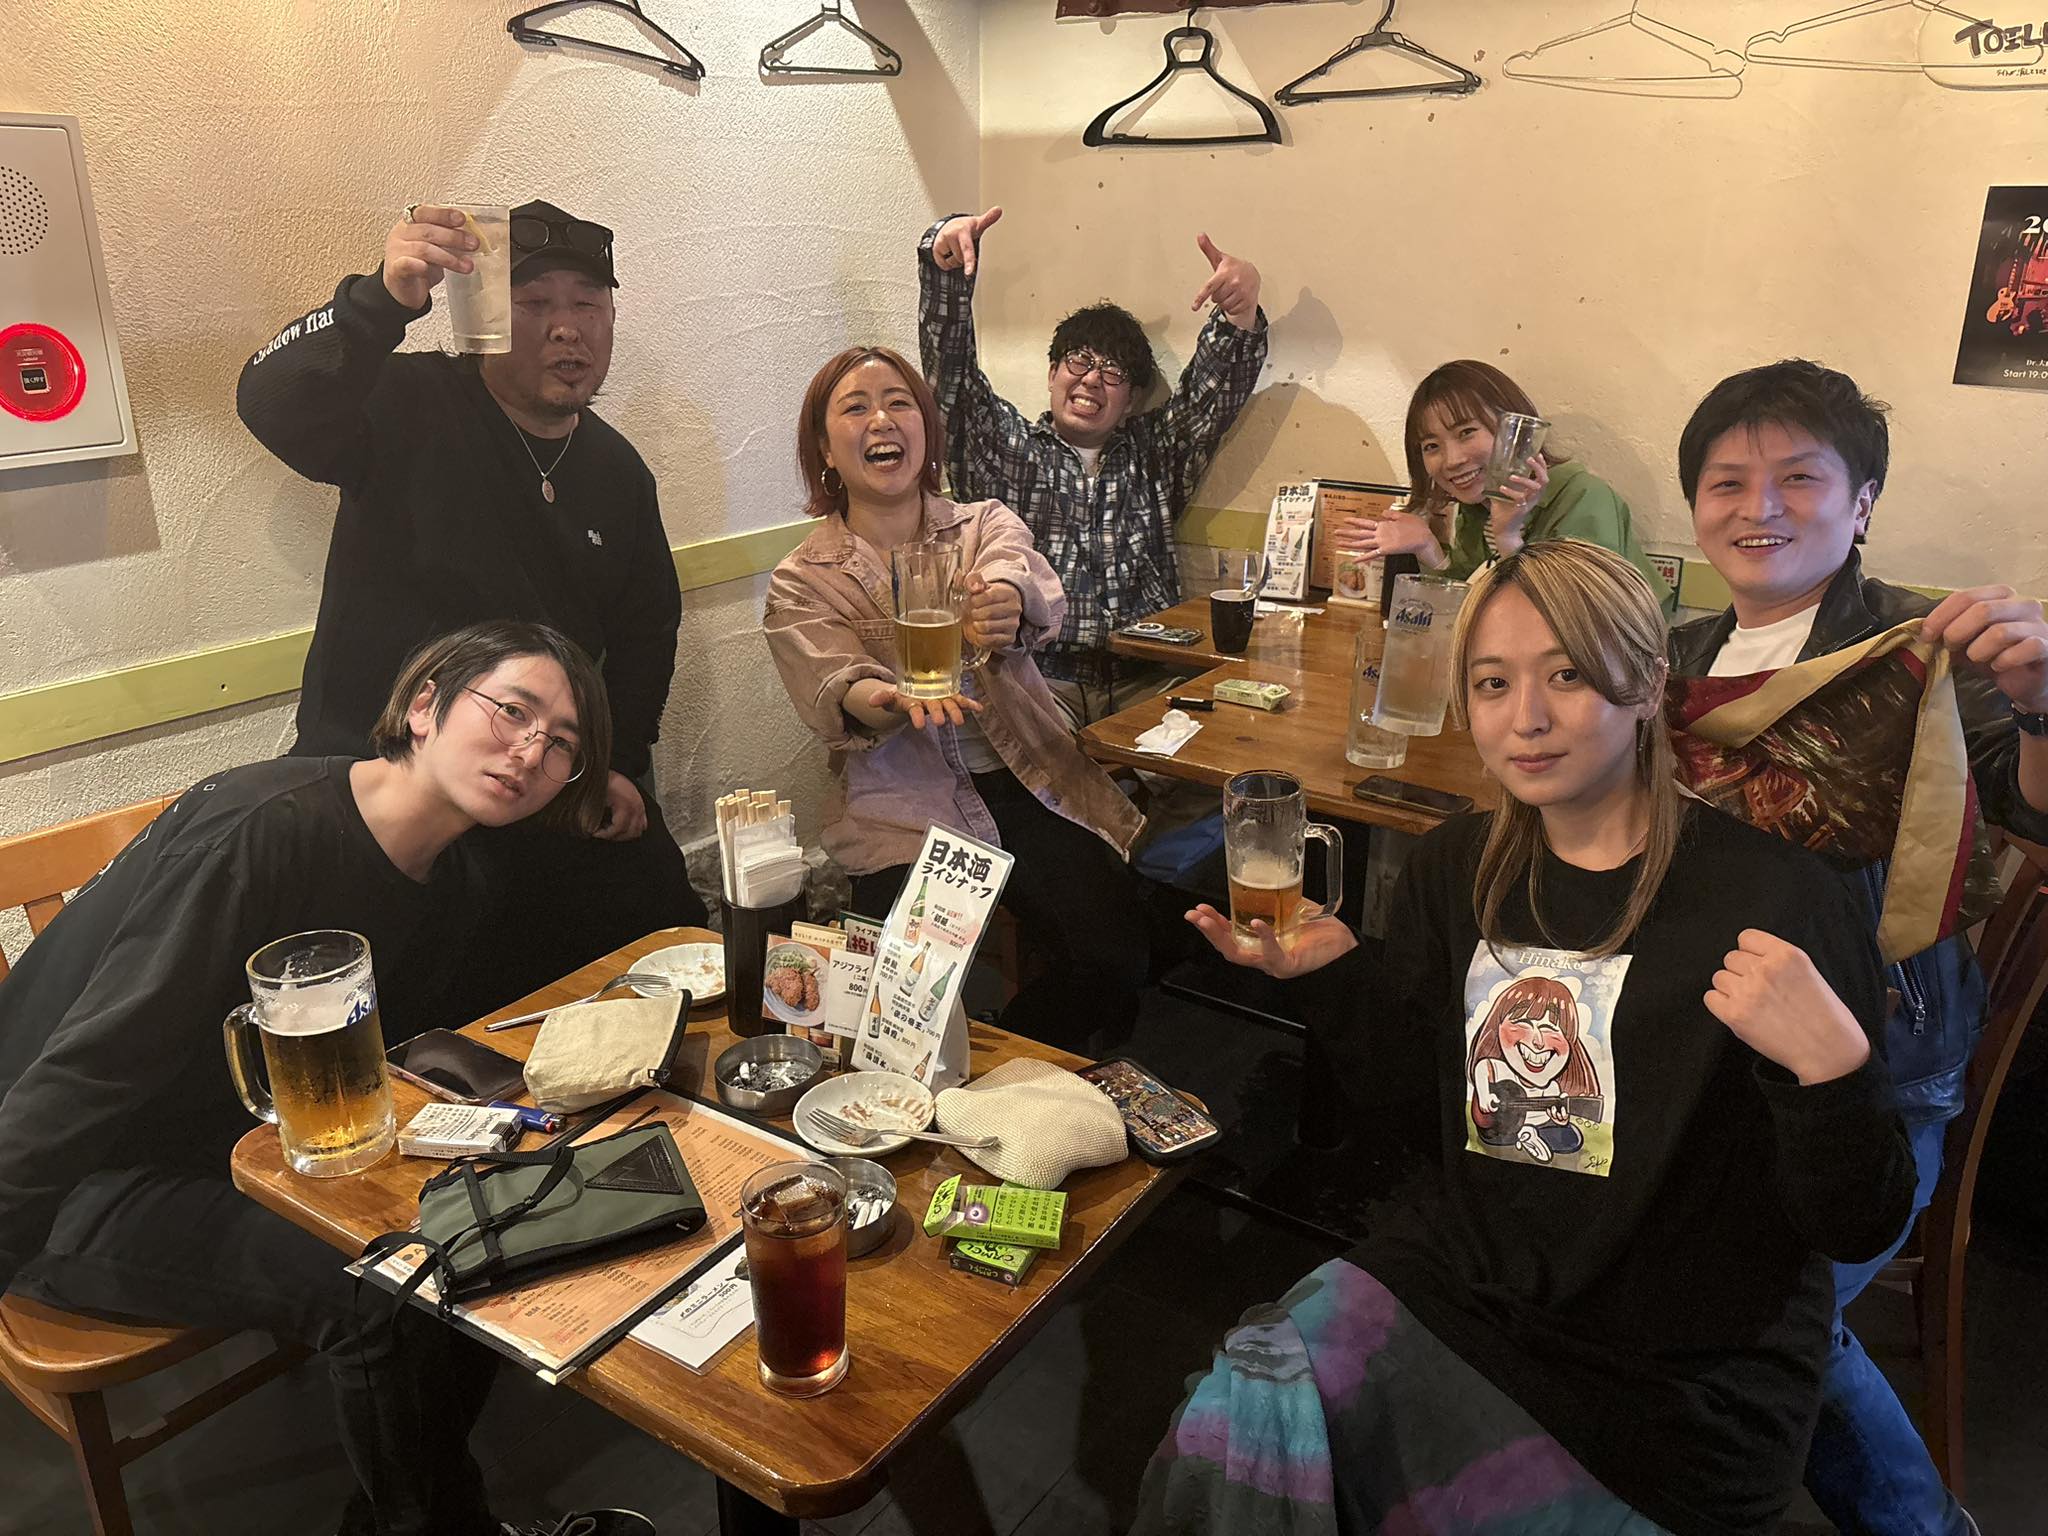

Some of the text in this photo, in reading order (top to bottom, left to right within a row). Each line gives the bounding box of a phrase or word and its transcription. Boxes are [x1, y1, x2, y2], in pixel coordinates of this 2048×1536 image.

[1955, 18, 2048, 58] TOIL
[2003, 369, 2026, 379] Start
[1278, 485, 1311, 496] 日本酒
[1396, 608, 1433, 627] Asahi
[1362, 665, 1381, 679] As
[927, 838, 993, 883] 日本酒
[920, 861, 995, 899] ラインナップ
[832, 959, 870, 974] アジフライ
[1517, 951, 1585, 971] Hinako
[967, 1242, 1015, 1263] CAMEL
[968, 1263, 999, 1277] CAMEL
